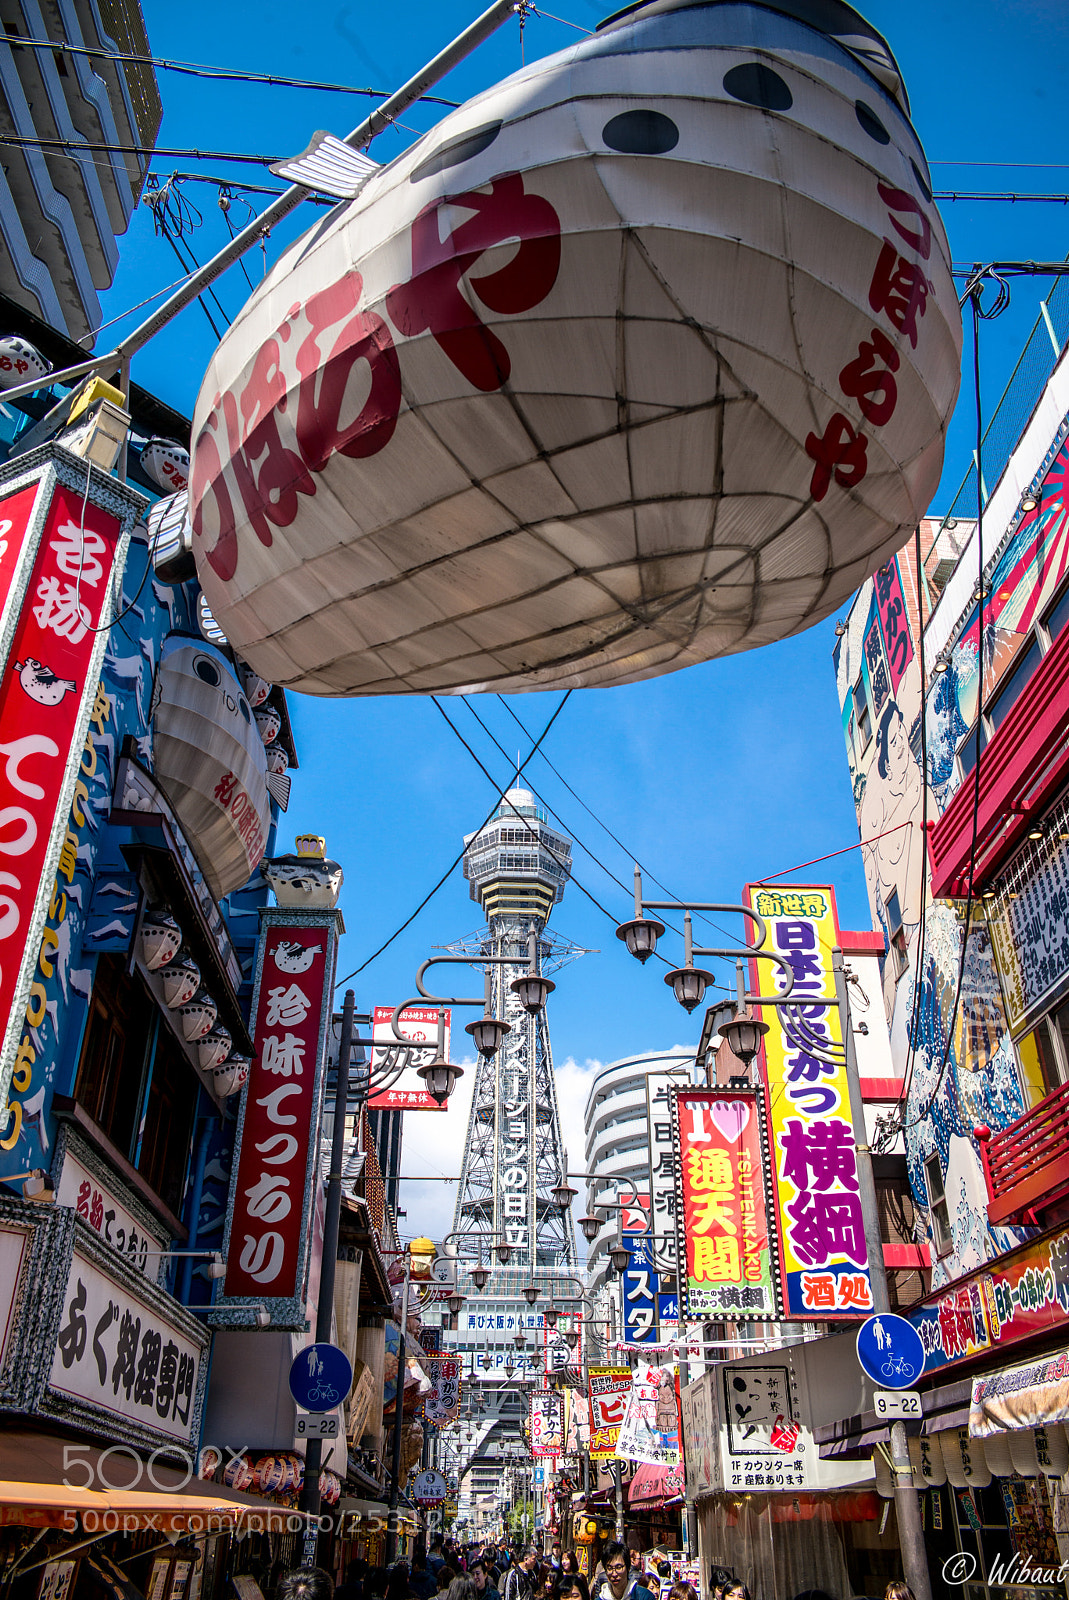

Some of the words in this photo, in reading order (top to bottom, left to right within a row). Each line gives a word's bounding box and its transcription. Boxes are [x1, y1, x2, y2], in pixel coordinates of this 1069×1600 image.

[757, 892, 827, 917] 新世界
[387, 1091, 429, 1104] 年中無休
[781, 1120, 868, 1268] 横綱
[687, 1147, 742, 1283] 通天閣
[736, 1147, 763, 1282] TSUTENKAKU
[690, 1288, 718, 1297] 日本一の
[690, 1298, 718, 1308] 串かつ
[718, 1286, 765, 1310] 横綱
[804, 1274, 871, 1308] 酒処
[58, 1277, 196, 1427] ふぐ料理専門
[440, 1361, 459, 1409] 串かつ
[590, 1375, 612, 1388] 新世界
[878, 1397, 919, 1413] 9-22
[541, 1397, 561, 1440] 串かつ
[732, 1460, 741, 1471] 1F
[744, 1460, 804, 1471] カウンター席
[731, 1474, 742, 1485] 2F
[745, 1474, 805, 1486] 座敷あります
